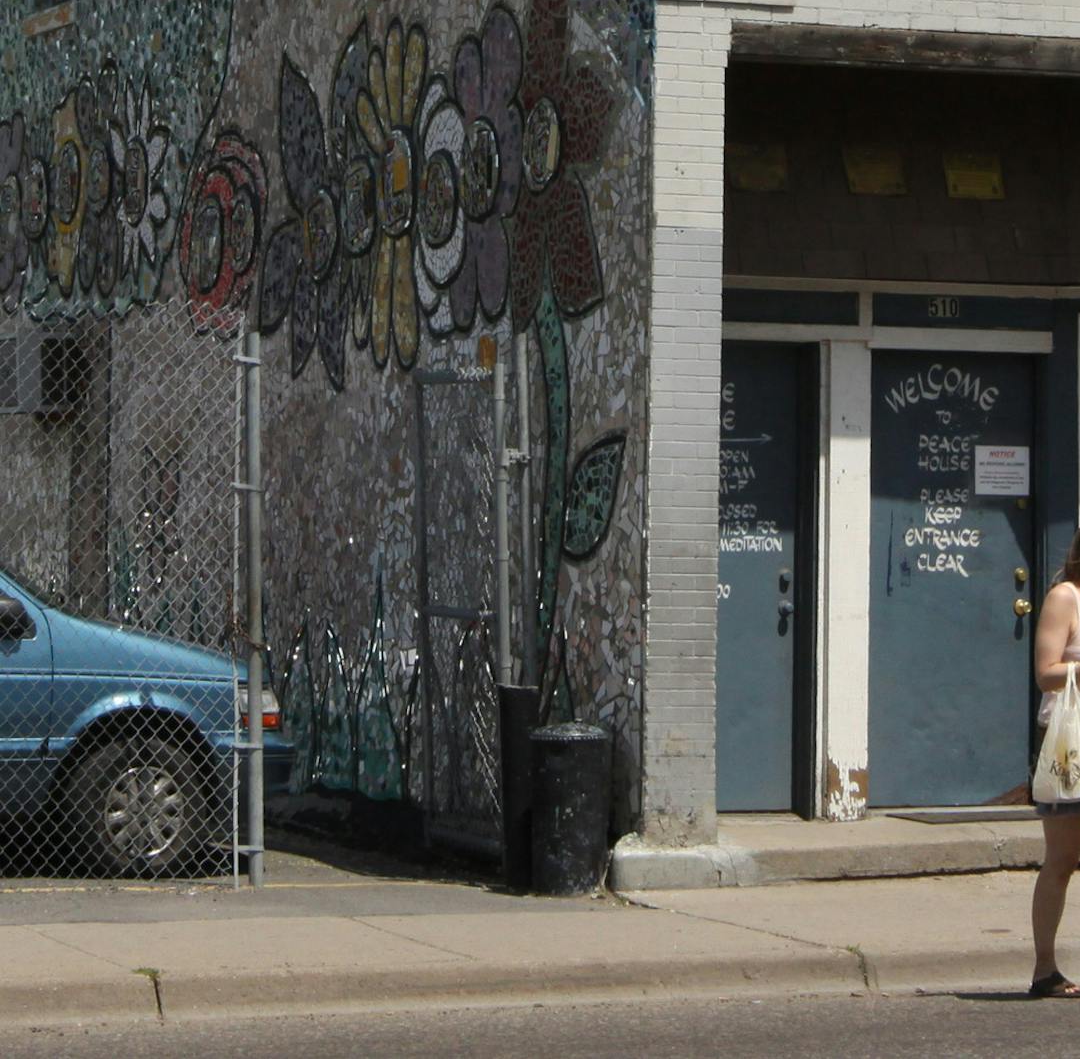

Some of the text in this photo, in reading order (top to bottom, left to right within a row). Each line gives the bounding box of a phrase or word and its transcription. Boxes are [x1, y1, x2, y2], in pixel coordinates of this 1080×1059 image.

[929, 298, 958, 316] 510
[885, 363, 999, 413] WELCOME
[936, 410, 951, 424] TO
[918, 434, 970, 453] PEACE
[918, 454, 971, 471] HOUSE
[920, 488, 970, 505] PLEASE
[924, 506, 962, 524] KEEP
[756, 521, 779, 536] FOR
[719, 536, 782, 552] MEDITATION
[904, 528, 981, 549] ENTRANCE
[917, 553, 970, 578] CLEAR
